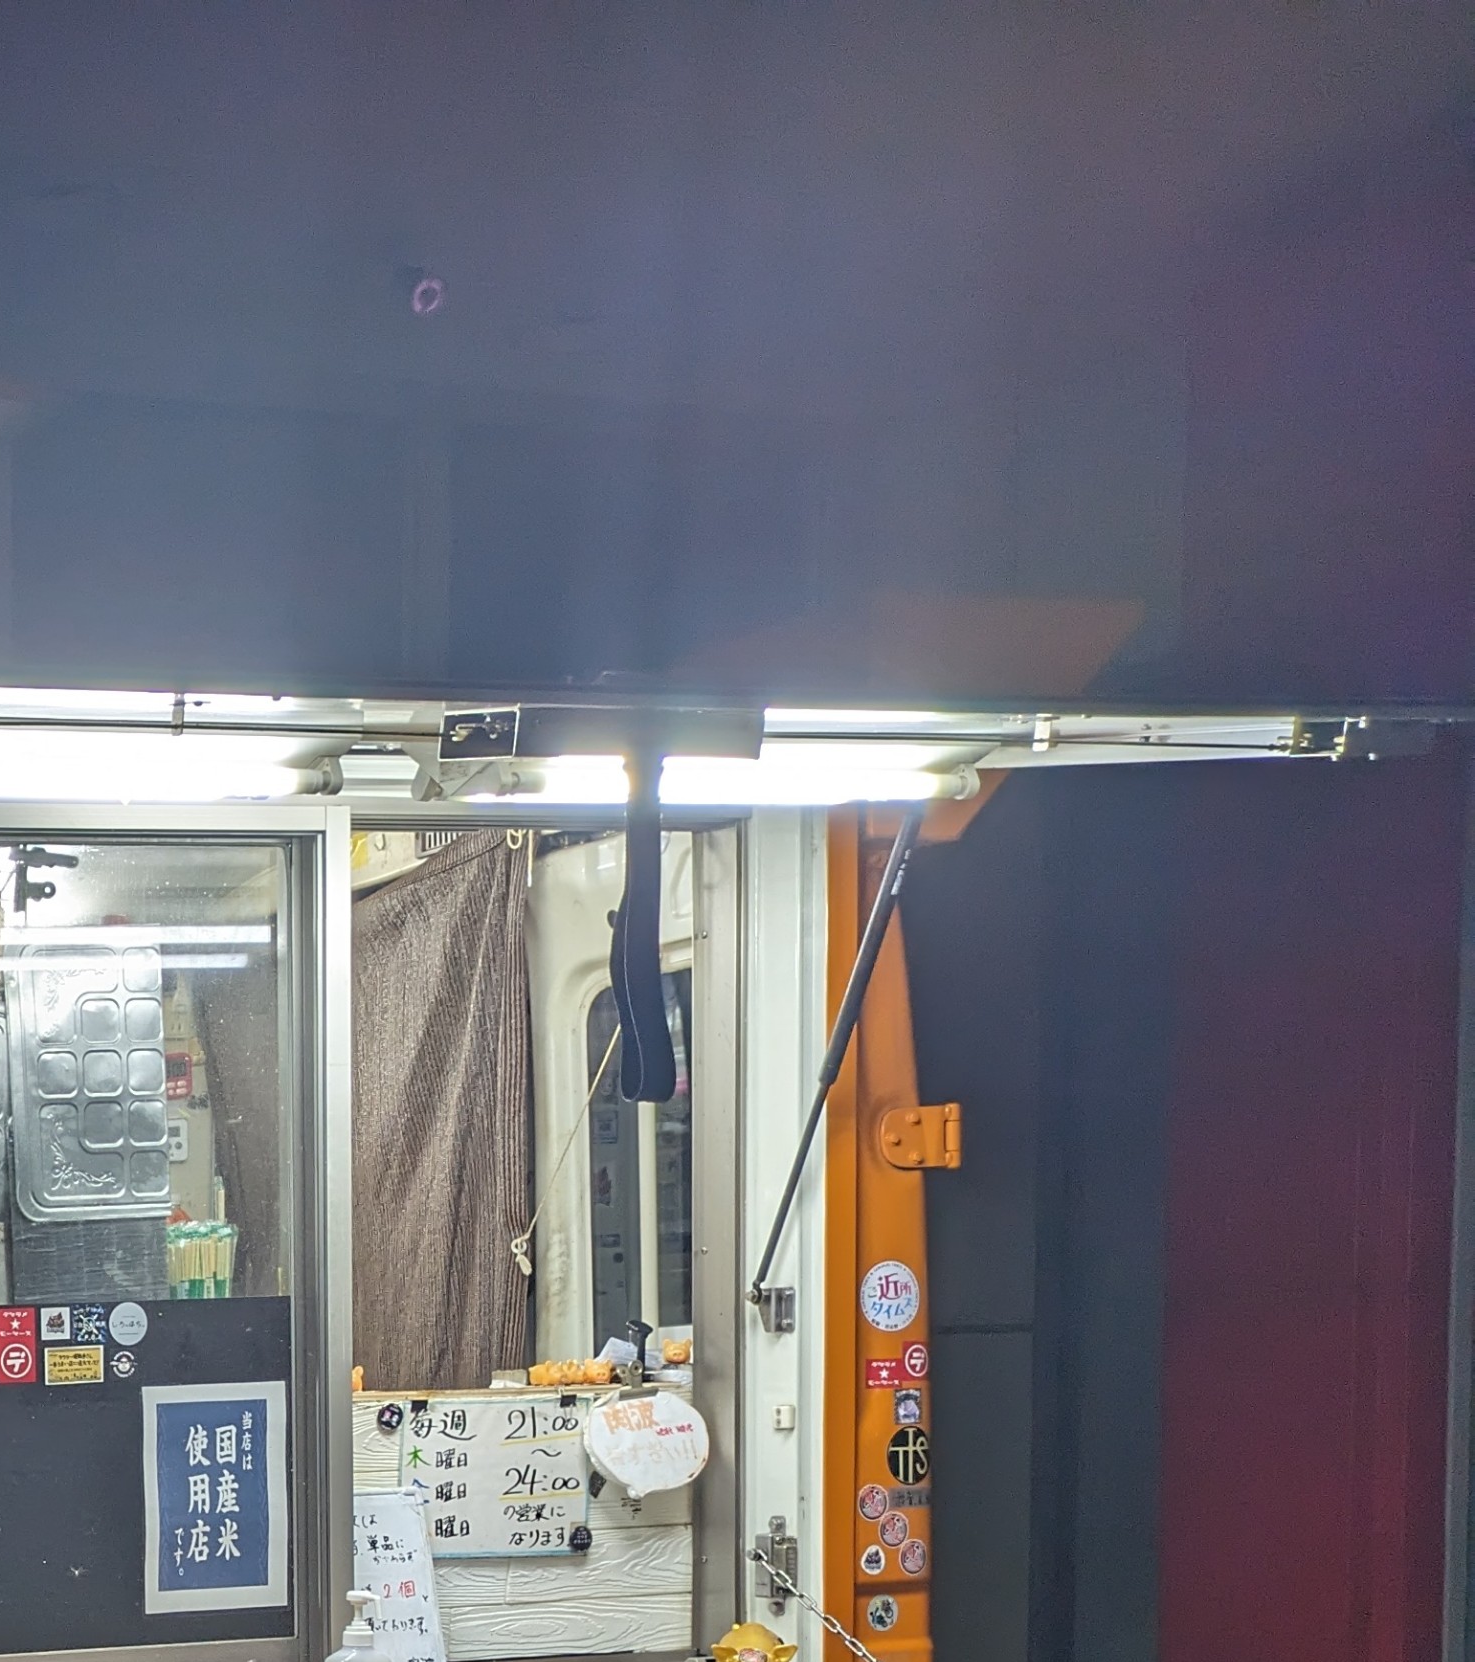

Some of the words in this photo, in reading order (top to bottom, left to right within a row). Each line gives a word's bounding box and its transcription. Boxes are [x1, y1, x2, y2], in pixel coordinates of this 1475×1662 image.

[241, 1411, 253, 1470] 当店は
[410, 1408, 477, 1441] 毎週
[504, 1406, 579, 1441] 21:00
[185, 1424, 211, 1562] 使用店
[214, 1424, 241, 1560] 国産米
[502, 1463, 580, 1496] 24:00
[174, 1528, 185, 1577] です。
